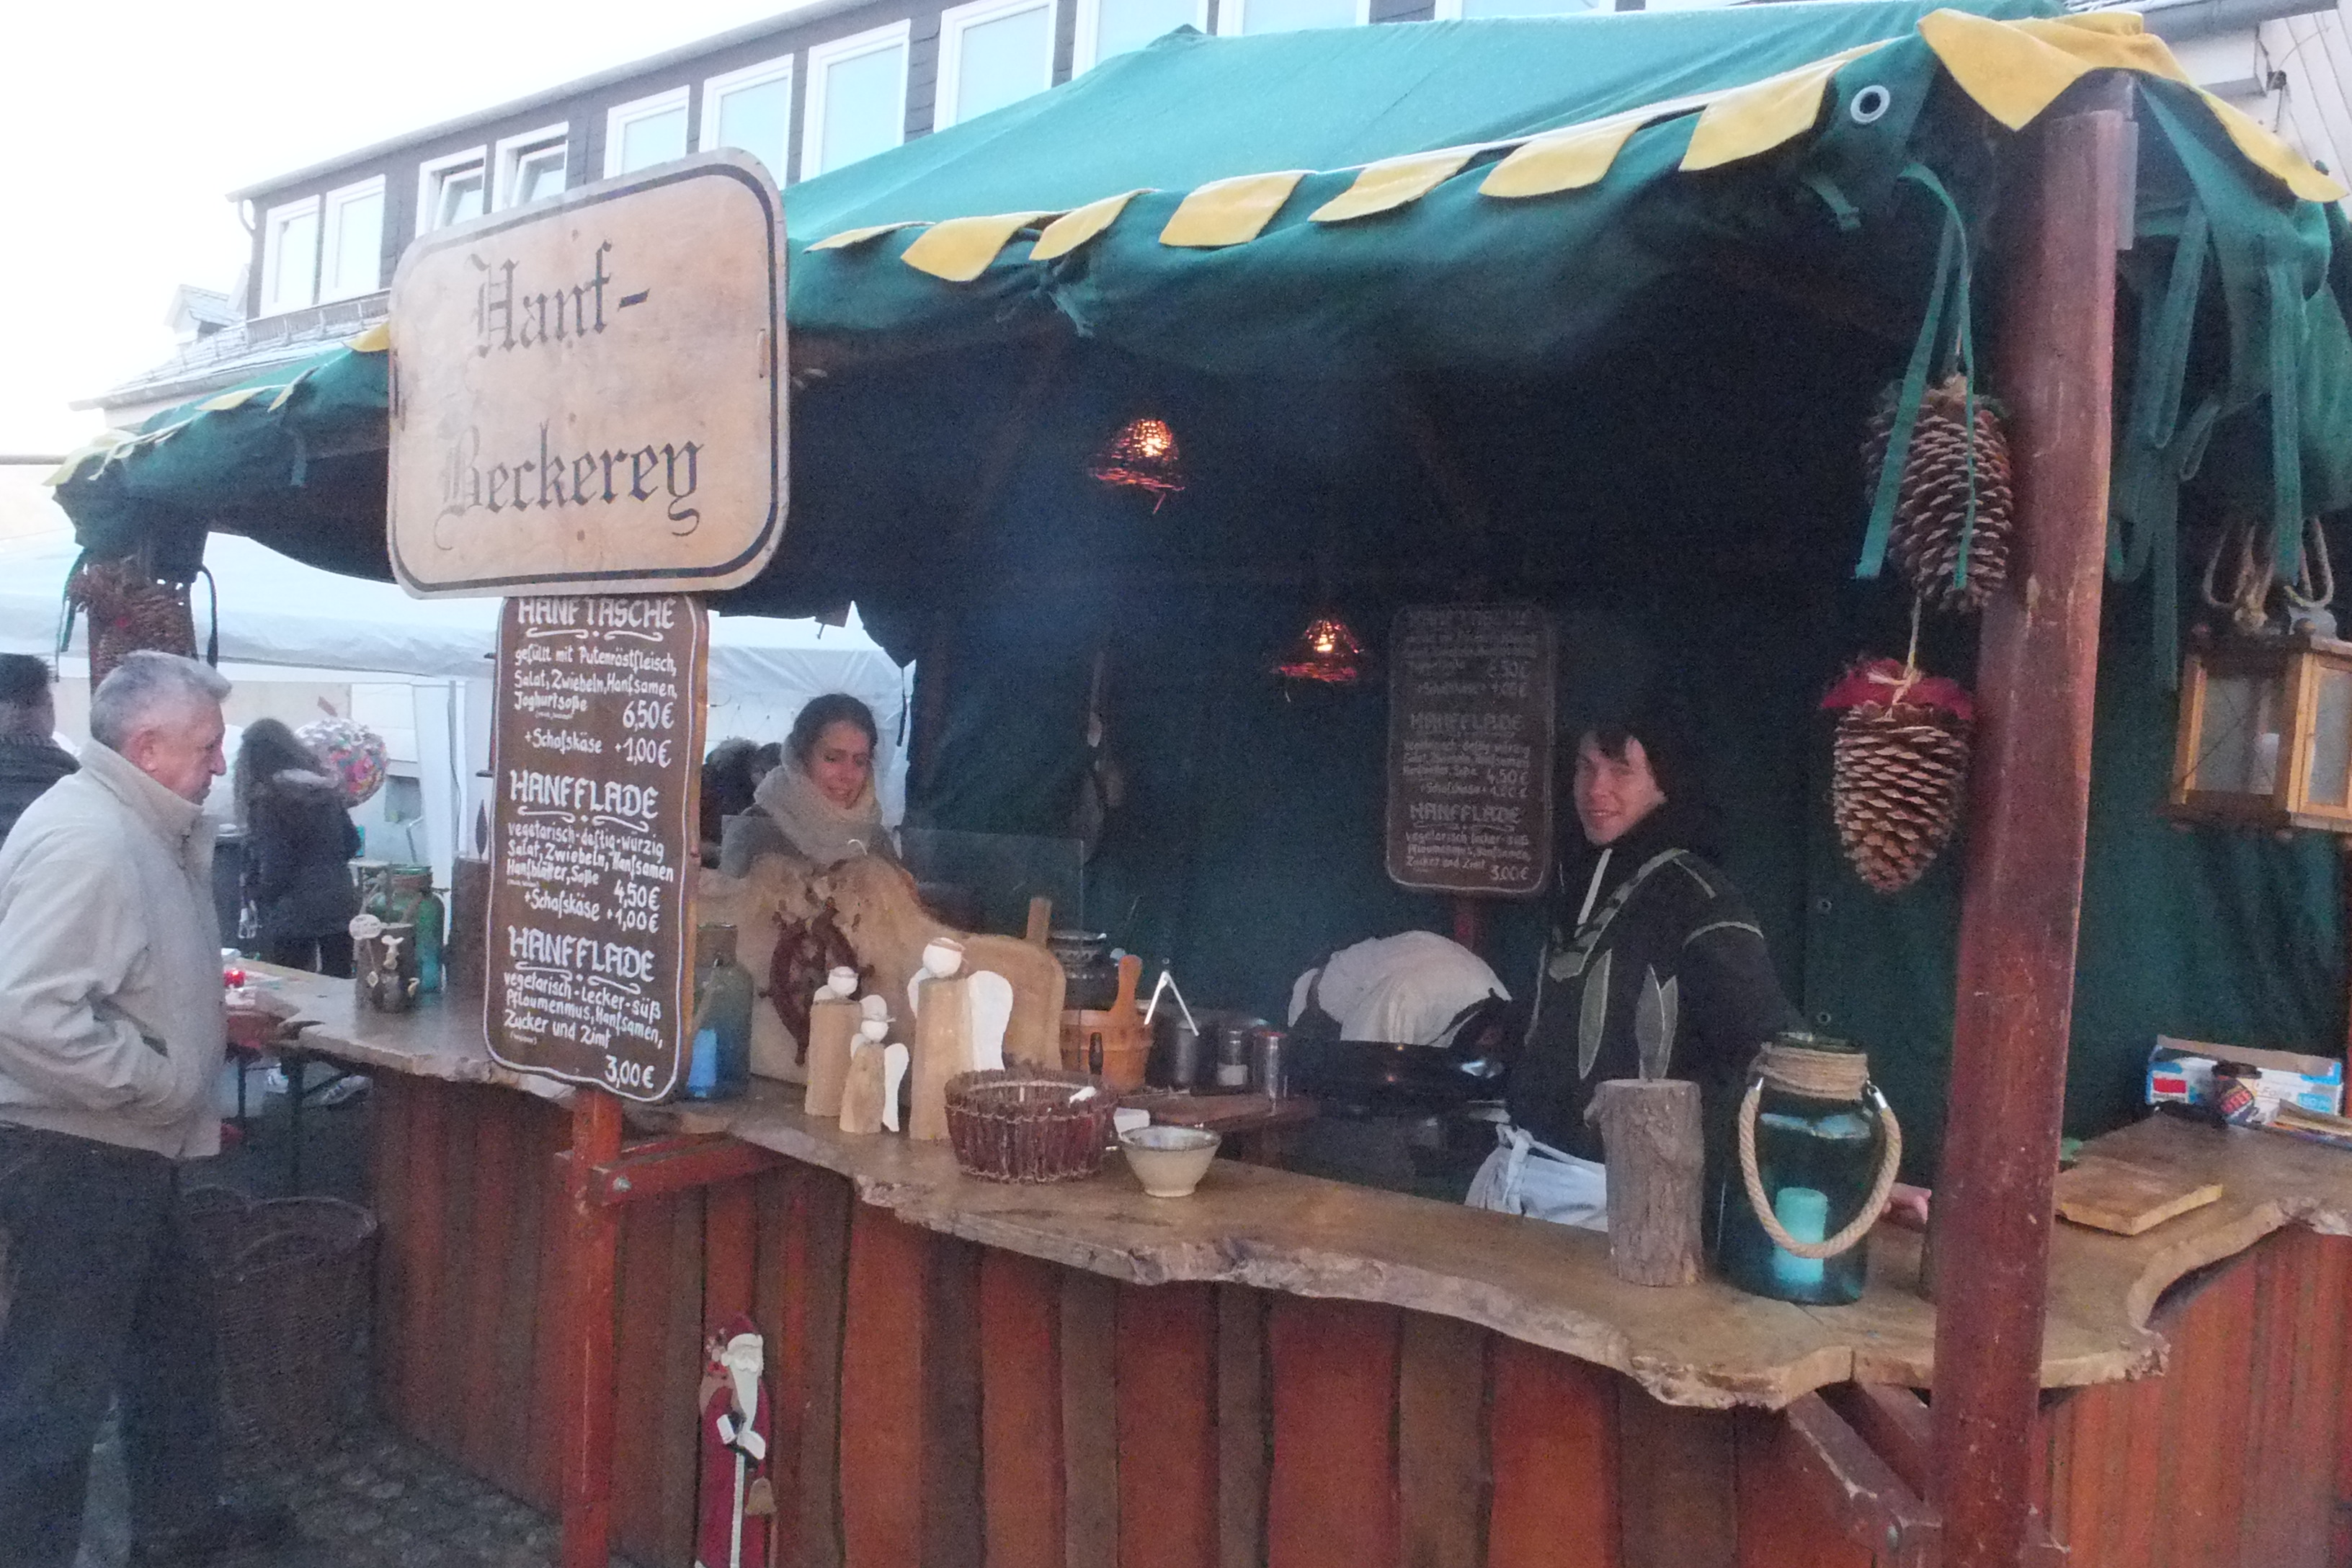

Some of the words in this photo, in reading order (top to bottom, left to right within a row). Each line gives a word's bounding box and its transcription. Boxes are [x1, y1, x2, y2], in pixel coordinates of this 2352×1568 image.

[466, 237, 651, 358] Hanf-
[434, 415, 705, 551] Beckerey
[556, 646, 574, 664] mit
[514, 690, 588, 714] Joghurtsoße
[504, 1009, 548, 1033] Zucker
[552, 1020, 576, 1041] und
[581, 1025, 611, 1049] Zimt
[605, 1054, 655, 1089] 3,00€
